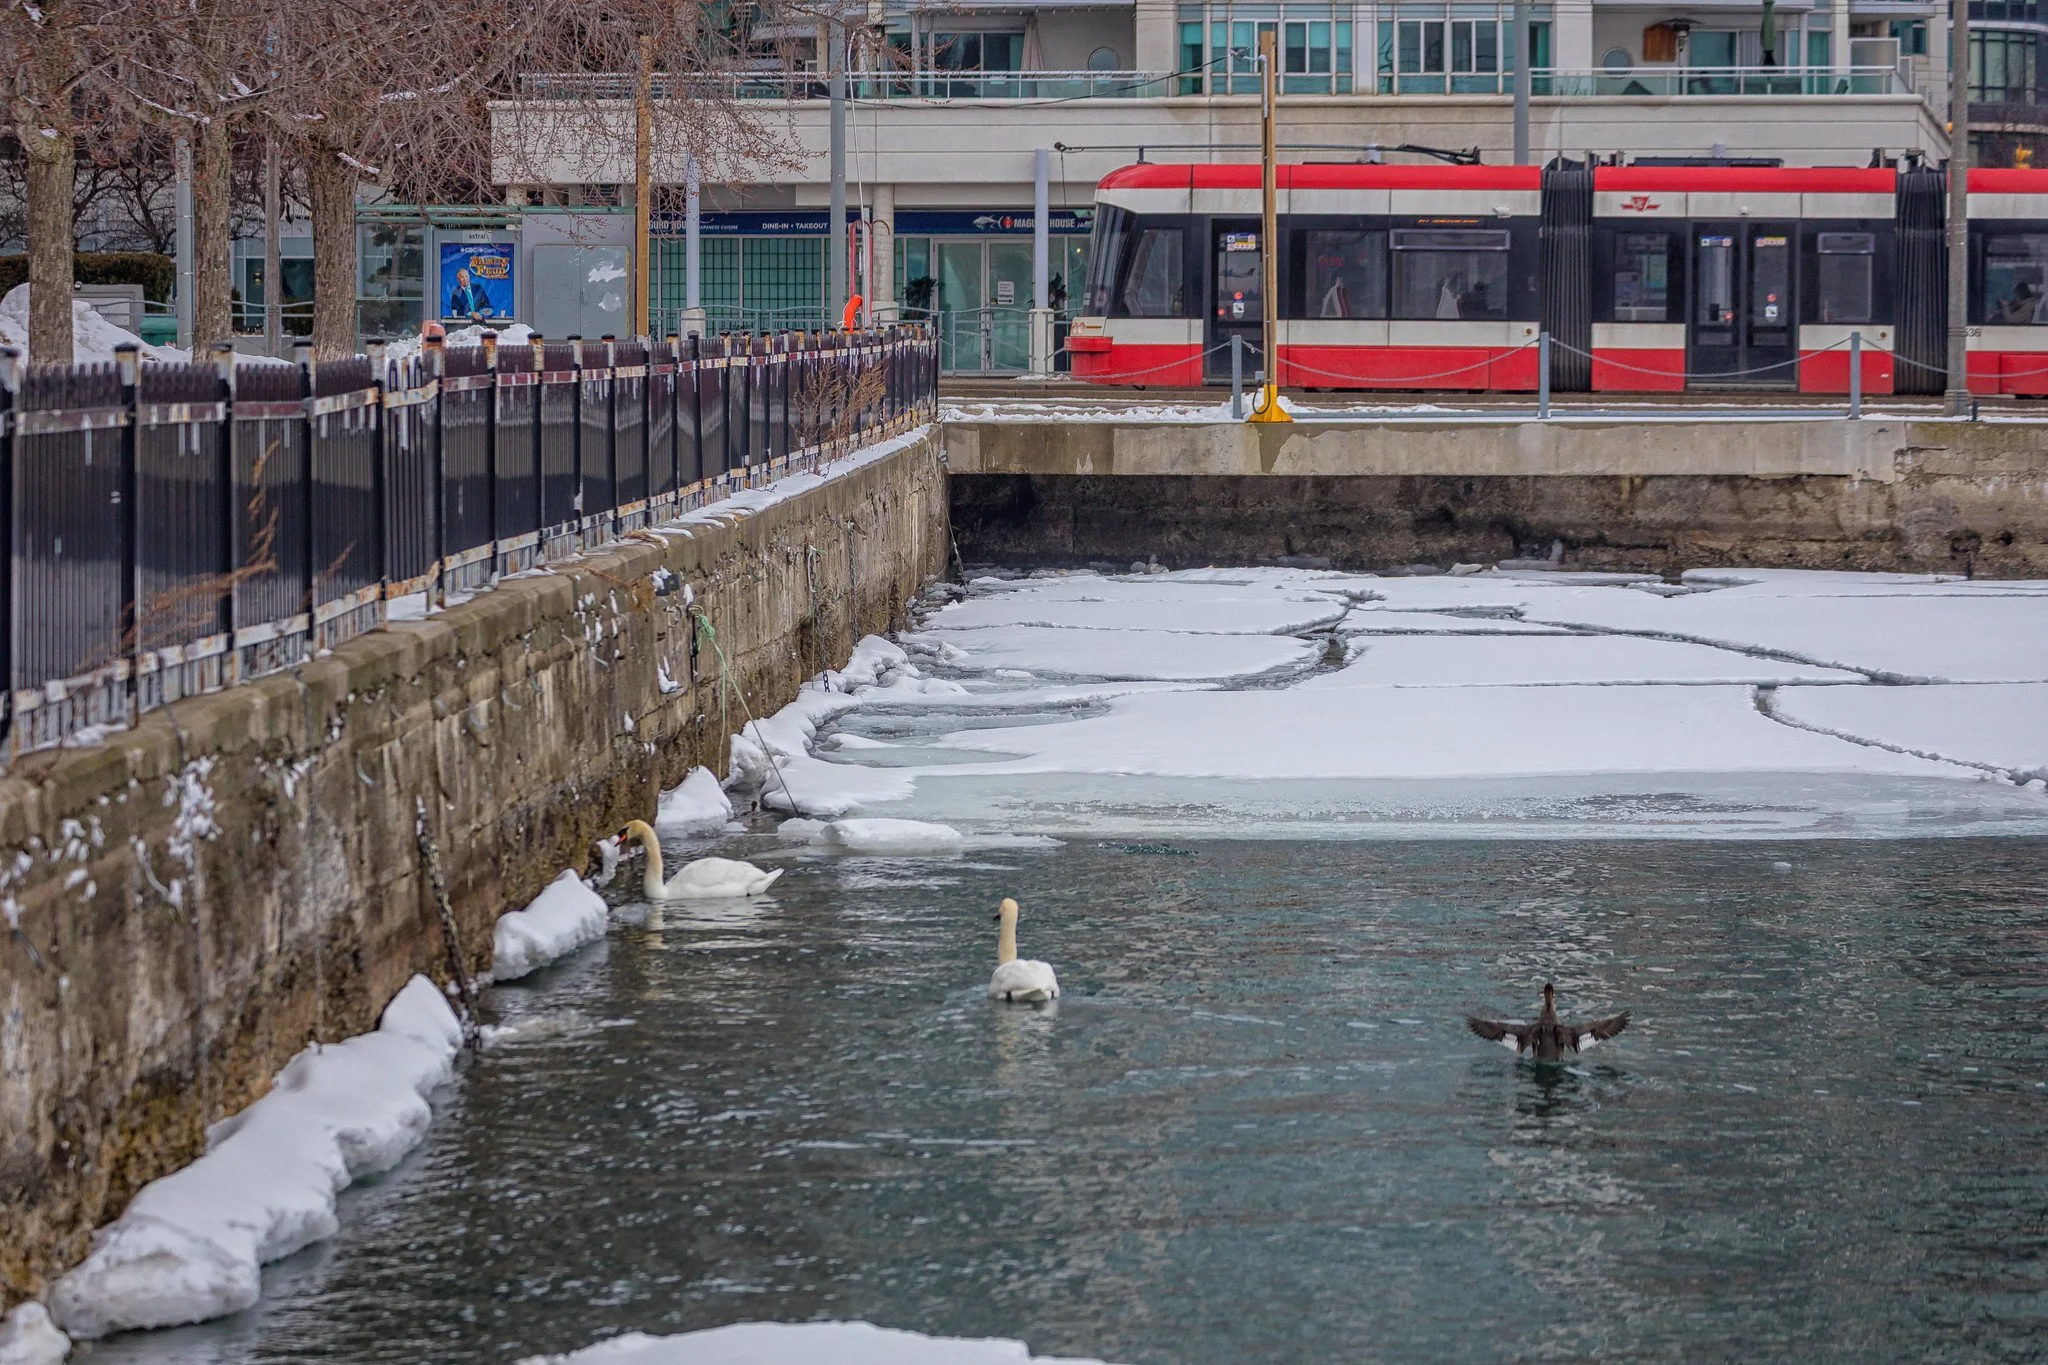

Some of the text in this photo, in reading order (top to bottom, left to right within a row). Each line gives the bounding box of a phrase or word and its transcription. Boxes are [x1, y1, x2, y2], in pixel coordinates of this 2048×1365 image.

[762, 222, 828, 230] DINE-IN TAKEOUT
[1049, 218, 1076, 228] HOUSE
